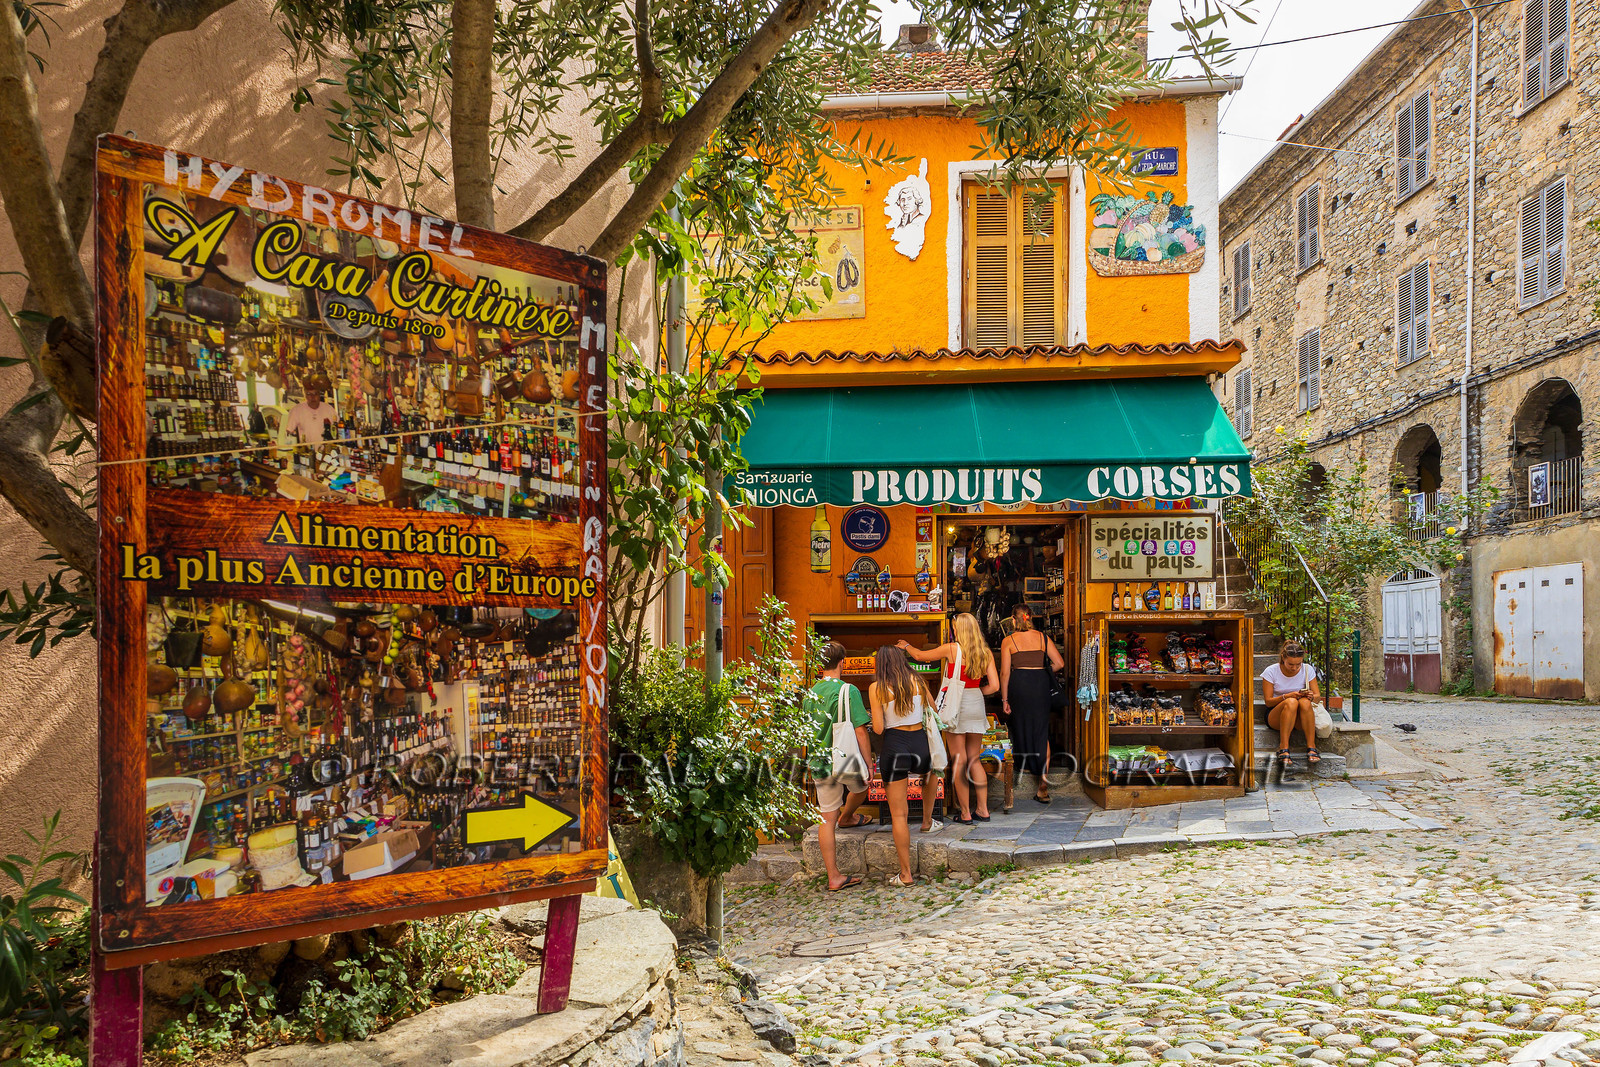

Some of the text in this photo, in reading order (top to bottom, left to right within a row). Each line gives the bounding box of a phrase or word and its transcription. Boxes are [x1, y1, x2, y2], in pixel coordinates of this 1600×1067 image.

[164, 150, 475, 258] HYDROMEL
[146, 199, 574, 337] A Casa Curtinese
[329, 302, 445, 339] Depuis 1800
[580, 315, 606, 432] MIEL
[851, 464, 1241, 503] PRODUITS CORSES
[266, 513, 498, 558] Alimentation
[1094, 521, 1208, 547] spécialités
[121, 545, 597, 605] la plus Ancienne d’Europe
[1108, 551, 1134, 570] du
[584, 515, 607, 709] RAYON
